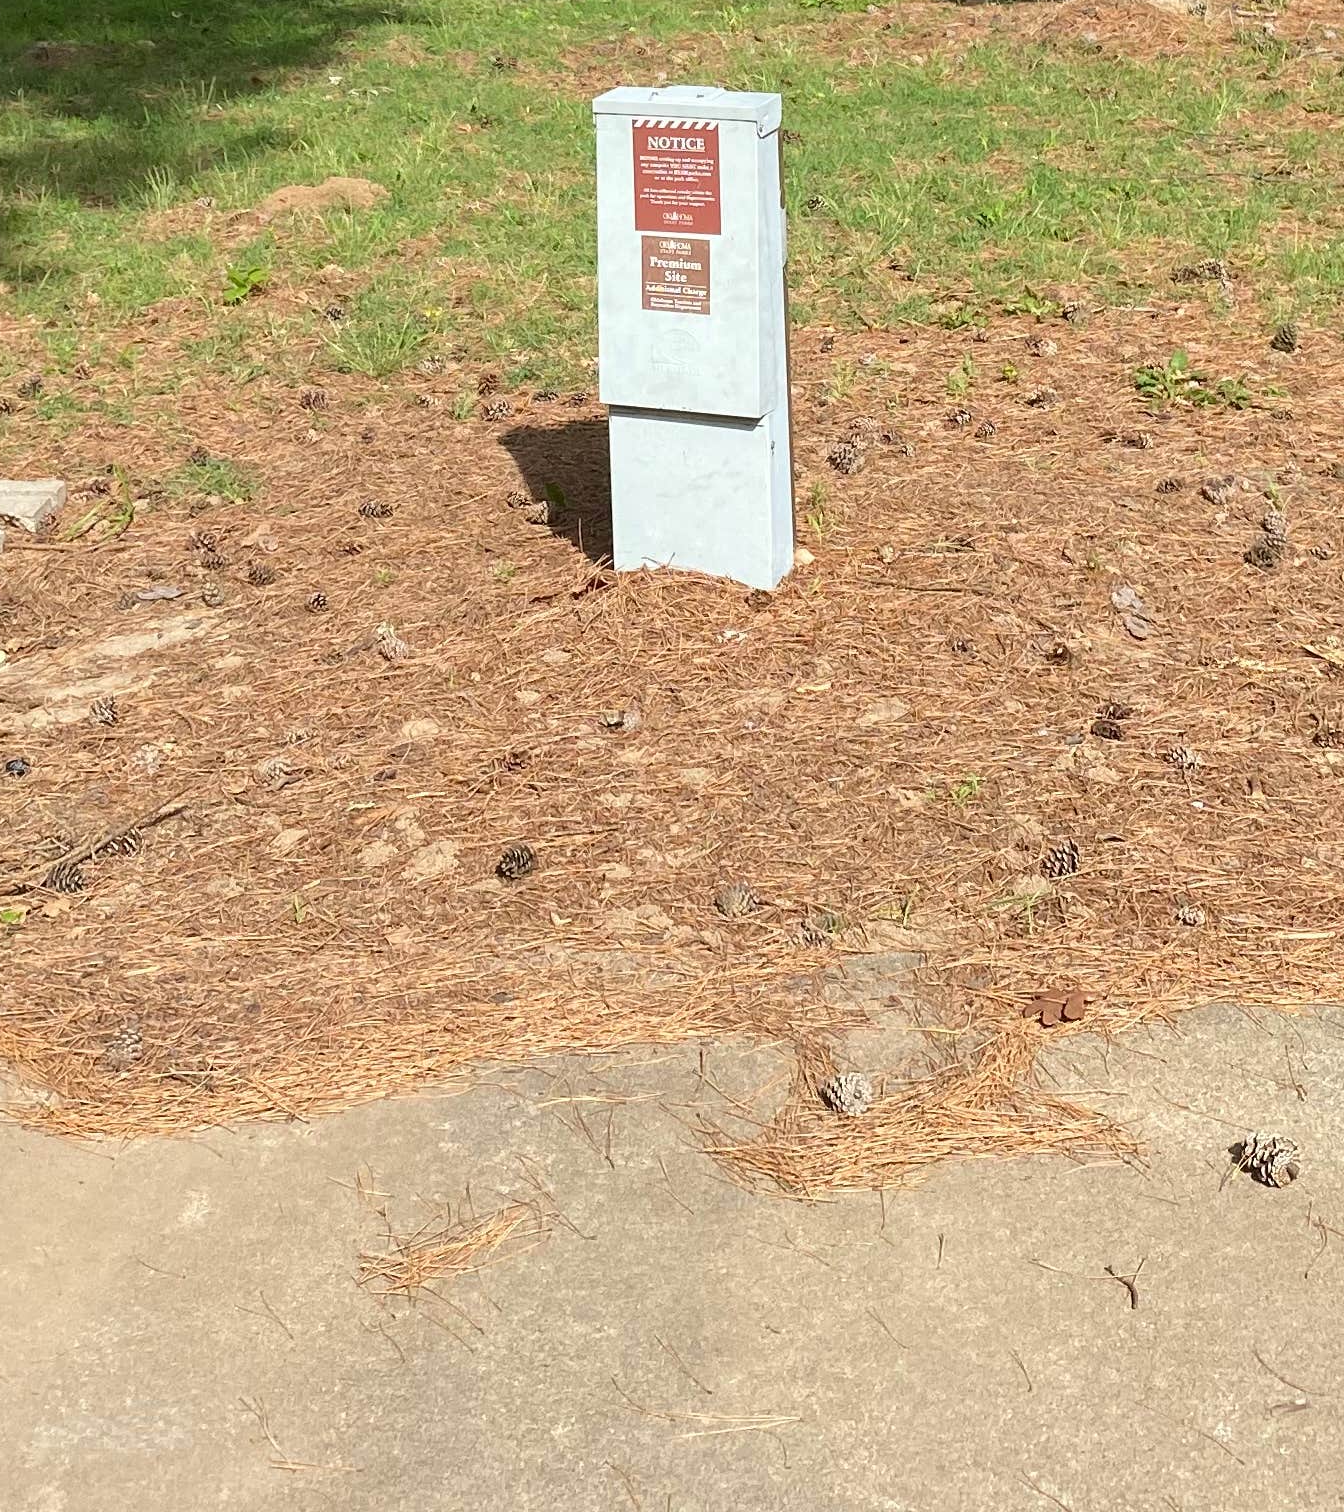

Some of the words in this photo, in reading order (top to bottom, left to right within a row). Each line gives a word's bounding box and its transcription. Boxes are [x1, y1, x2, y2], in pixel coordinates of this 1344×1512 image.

[647, 136, 705, 150] NOTICE
[649, 256, 702, 270] Premium
[664, 270, 687, 282] Site
[645, 285, 681, 294] Additional
[682, 287, 707, 296] Charge
